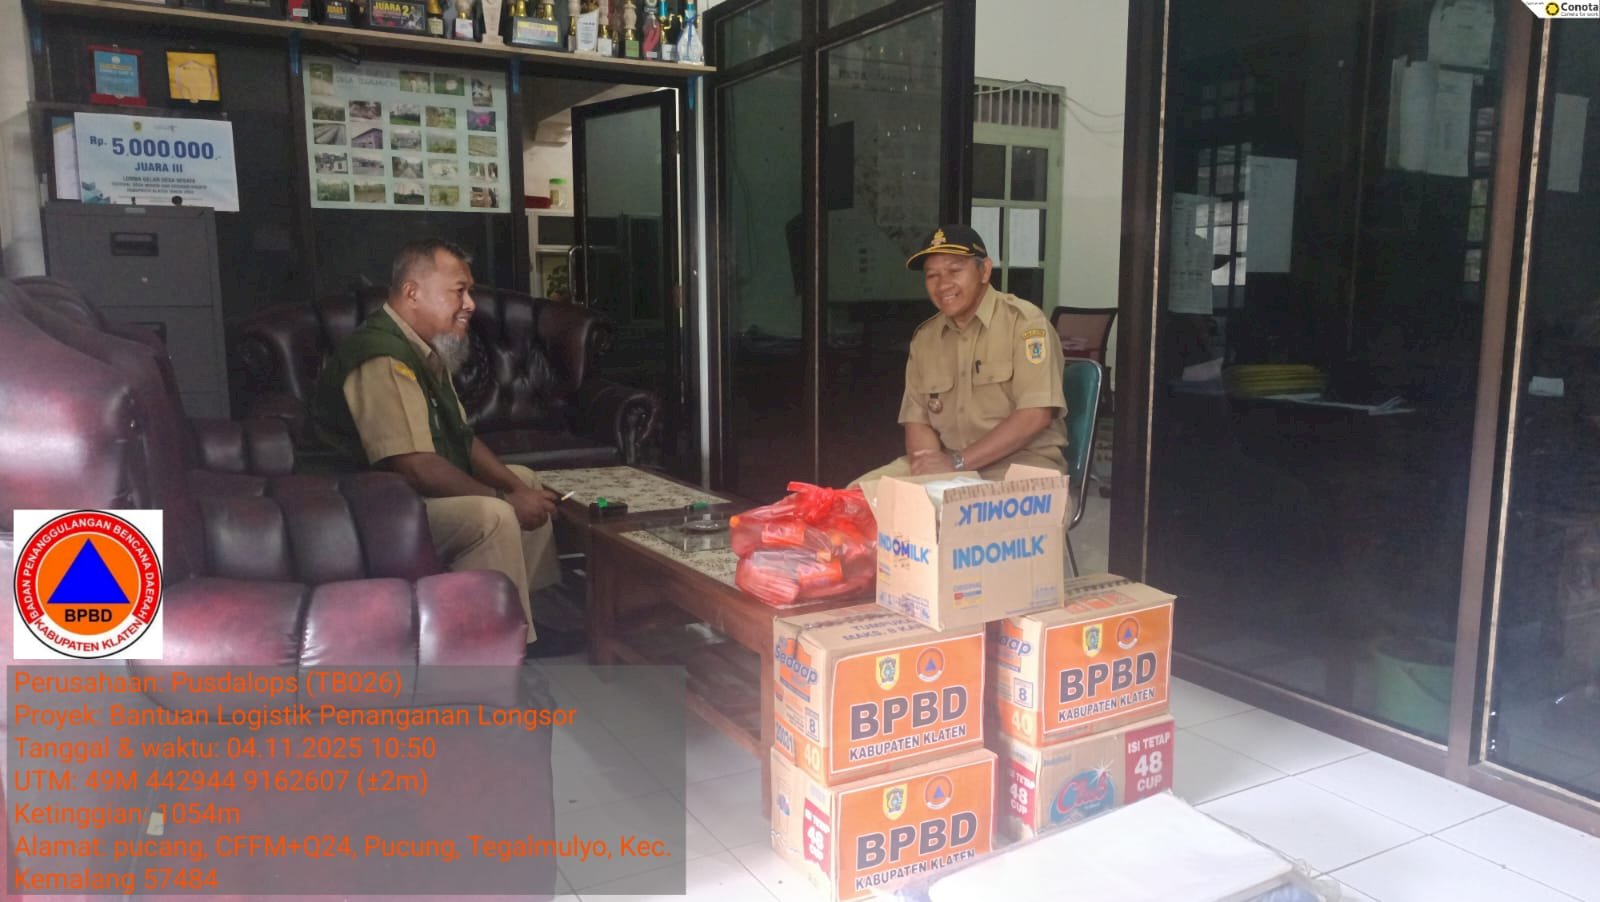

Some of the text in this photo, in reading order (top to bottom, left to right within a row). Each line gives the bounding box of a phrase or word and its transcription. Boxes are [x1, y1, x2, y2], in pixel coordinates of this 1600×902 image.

[373, 1, 402, 12] JUARA
[402, 5, 410, 16] 2
[89, 135, 107, 147] Rp.
[134, 162, 183, 173] JUARA III
[957, 494, 1052, 526] INDOMILK
[878, 531, 929, 565] INDOMILK
[953, 535, 1046, 570] INDOMILK
[774, 644, 818, 684] Sedaap
[1059, 651, 1157, 705] BPBD
[1018, 686, 1028, 702] 8
[1058, 687, 1155, 722] KABUPATEN KLATEN
[850, 684, 968, 741] BPBD
[1011, 712, 1034, 734] 40
[803, 742, 819, 770] 40
[850, 724, 967, 760] KABUPATEN KLATEN
[1127, 731, 1171, 754] ISI TETAP
[1134, 750, 1163, 776] 48
[1009, 782, 1028, 806] 48
[1137, 774, 1162, 792] CUP
[807, 826, 825, 851] 48
[856, 810, 978, 871] BPBD
[855, 861, 928, 890] KABUPATEN
